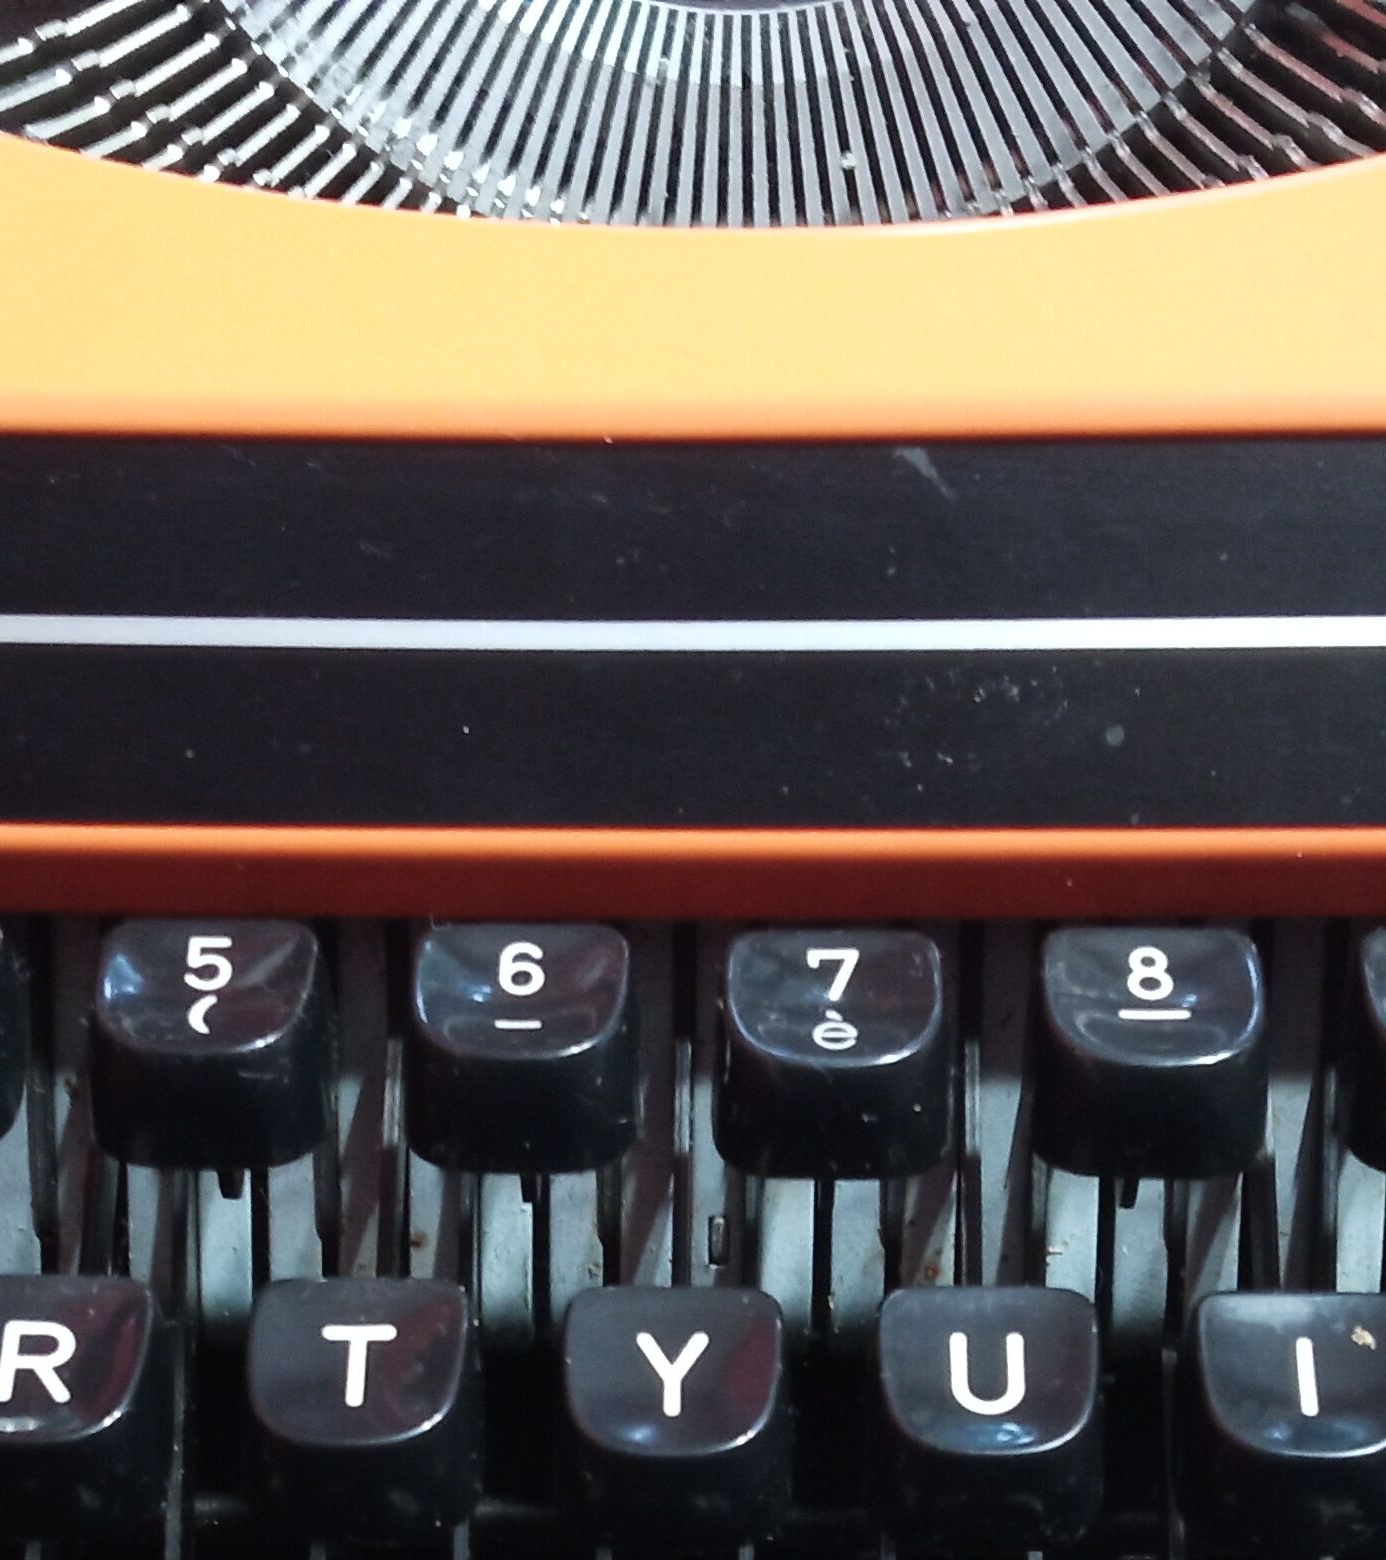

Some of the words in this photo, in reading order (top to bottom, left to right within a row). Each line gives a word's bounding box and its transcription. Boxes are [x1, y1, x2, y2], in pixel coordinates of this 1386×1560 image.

[182, 935, 234, 992] 5
[497, 940, 546, 997] 6
[805, 947, 861, 1003] 7
[1125, 945, 1175, 1002] 8
[811, 1008, 859, 1051] è
[320, 1322, 399, 1409] T
[635, 1331, 710, 1418] Y
[948, 1331, 1027, 1417] U
[1294, 1336, 1320, 1418] I
